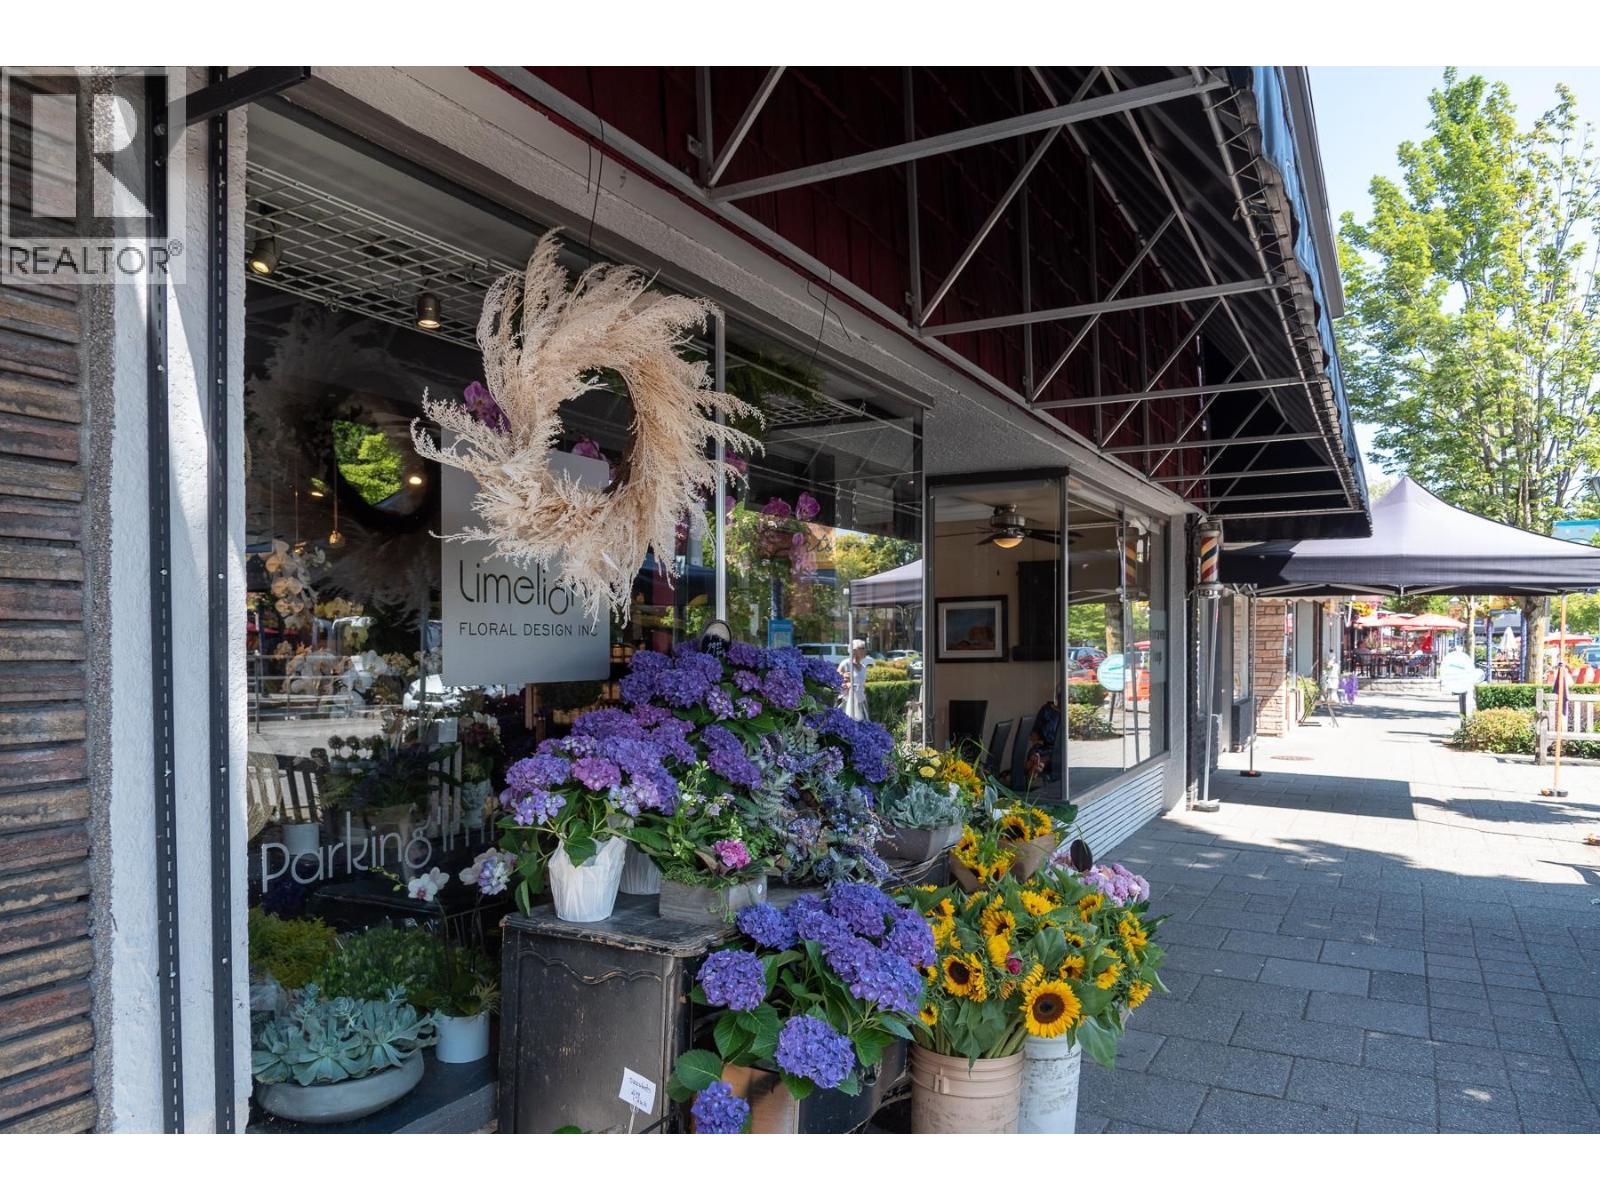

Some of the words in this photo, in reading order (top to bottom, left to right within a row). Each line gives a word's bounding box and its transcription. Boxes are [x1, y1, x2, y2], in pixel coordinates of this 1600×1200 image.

[459, 621, 518, 637] FLORAL
[523, 623, 573, 637] DESIGN
[578, 624, 599, 638] INC
[261, 810, 433, 894] parking
